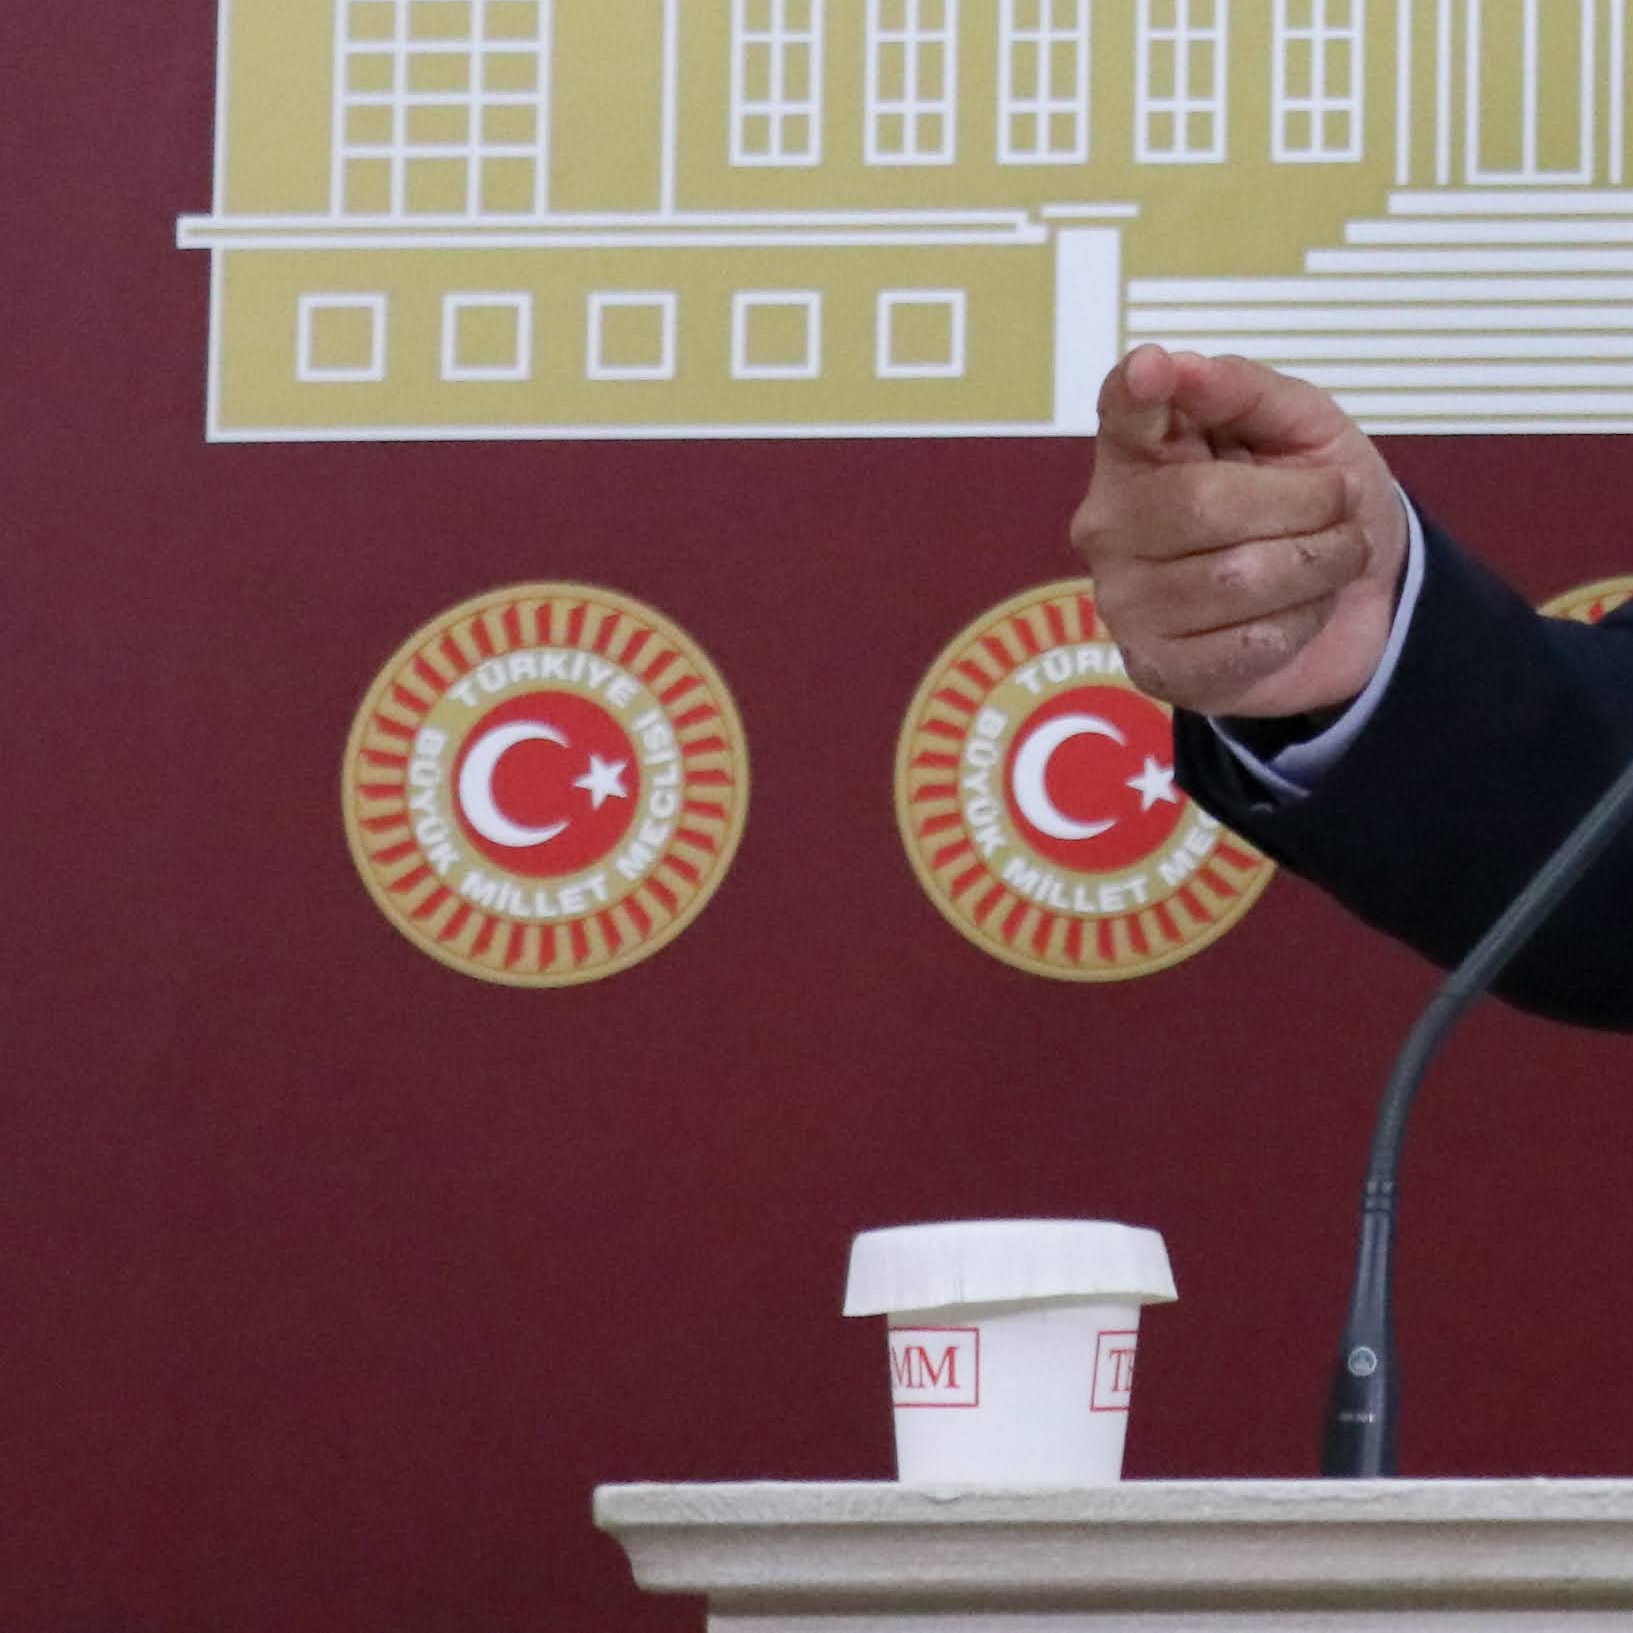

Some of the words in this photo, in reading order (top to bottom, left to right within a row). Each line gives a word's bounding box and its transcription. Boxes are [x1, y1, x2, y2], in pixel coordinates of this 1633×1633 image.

[448, 648, 643, 709] TÜRKİYE
[408, 726, 461, 876] BÜYÜK
[961, 707, 1009, 859] BÜYÜK
[1002, 856, 1149, 914] MİLLET
[459, 868, 612, 919] MİLLET
